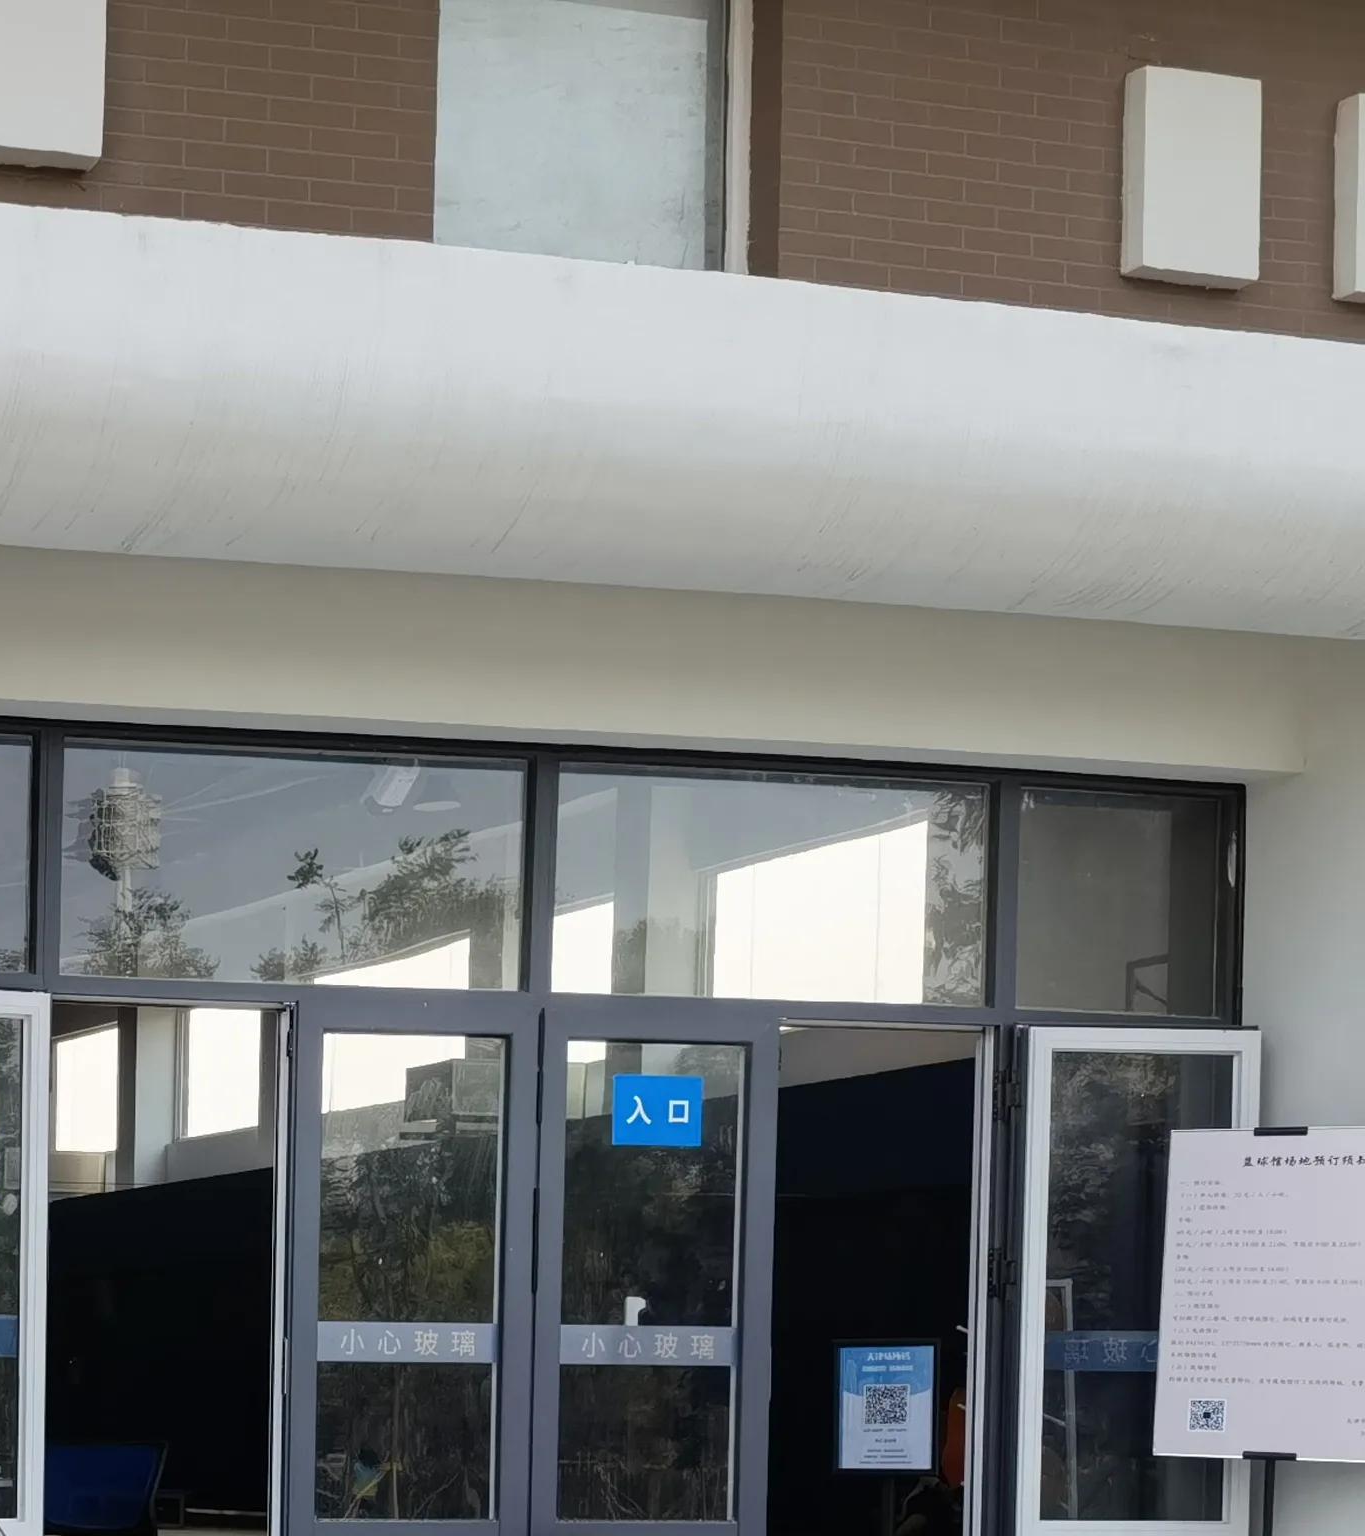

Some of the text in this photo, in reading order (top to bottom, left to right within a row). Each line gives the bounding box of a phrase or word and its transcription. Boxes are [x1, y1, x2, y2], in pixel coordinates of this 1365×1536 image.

[626, 1095, 689, 1125] 入口
[340, 1328, 476, 1358] 小心玻璃
[581, 1331, 717, 1361] 小心玻璃
